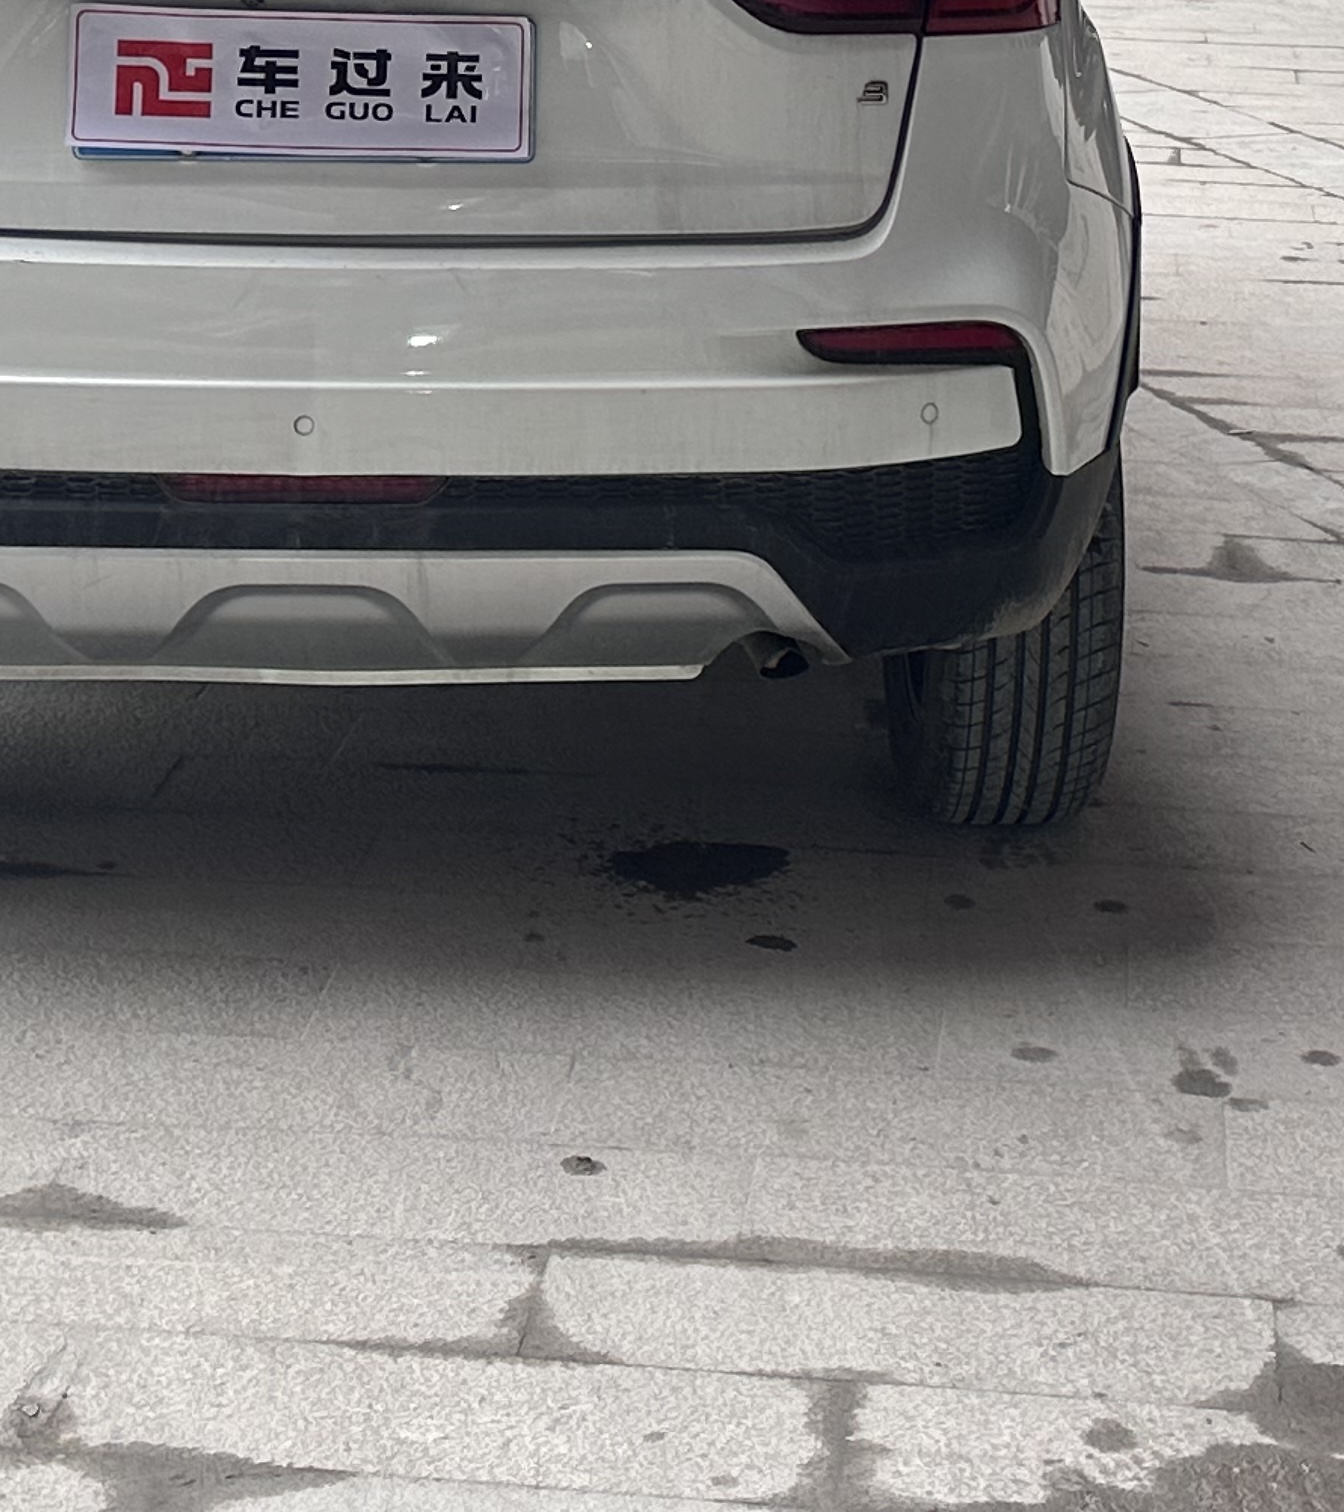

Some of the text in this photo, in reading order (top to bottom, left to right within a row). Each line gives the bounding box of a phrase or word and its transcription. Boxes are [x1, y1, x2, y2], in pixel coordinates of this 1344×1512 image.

[236, 45, 483, 100] 车过来
[234, 98, 478, 124] CHE GUO LAI
